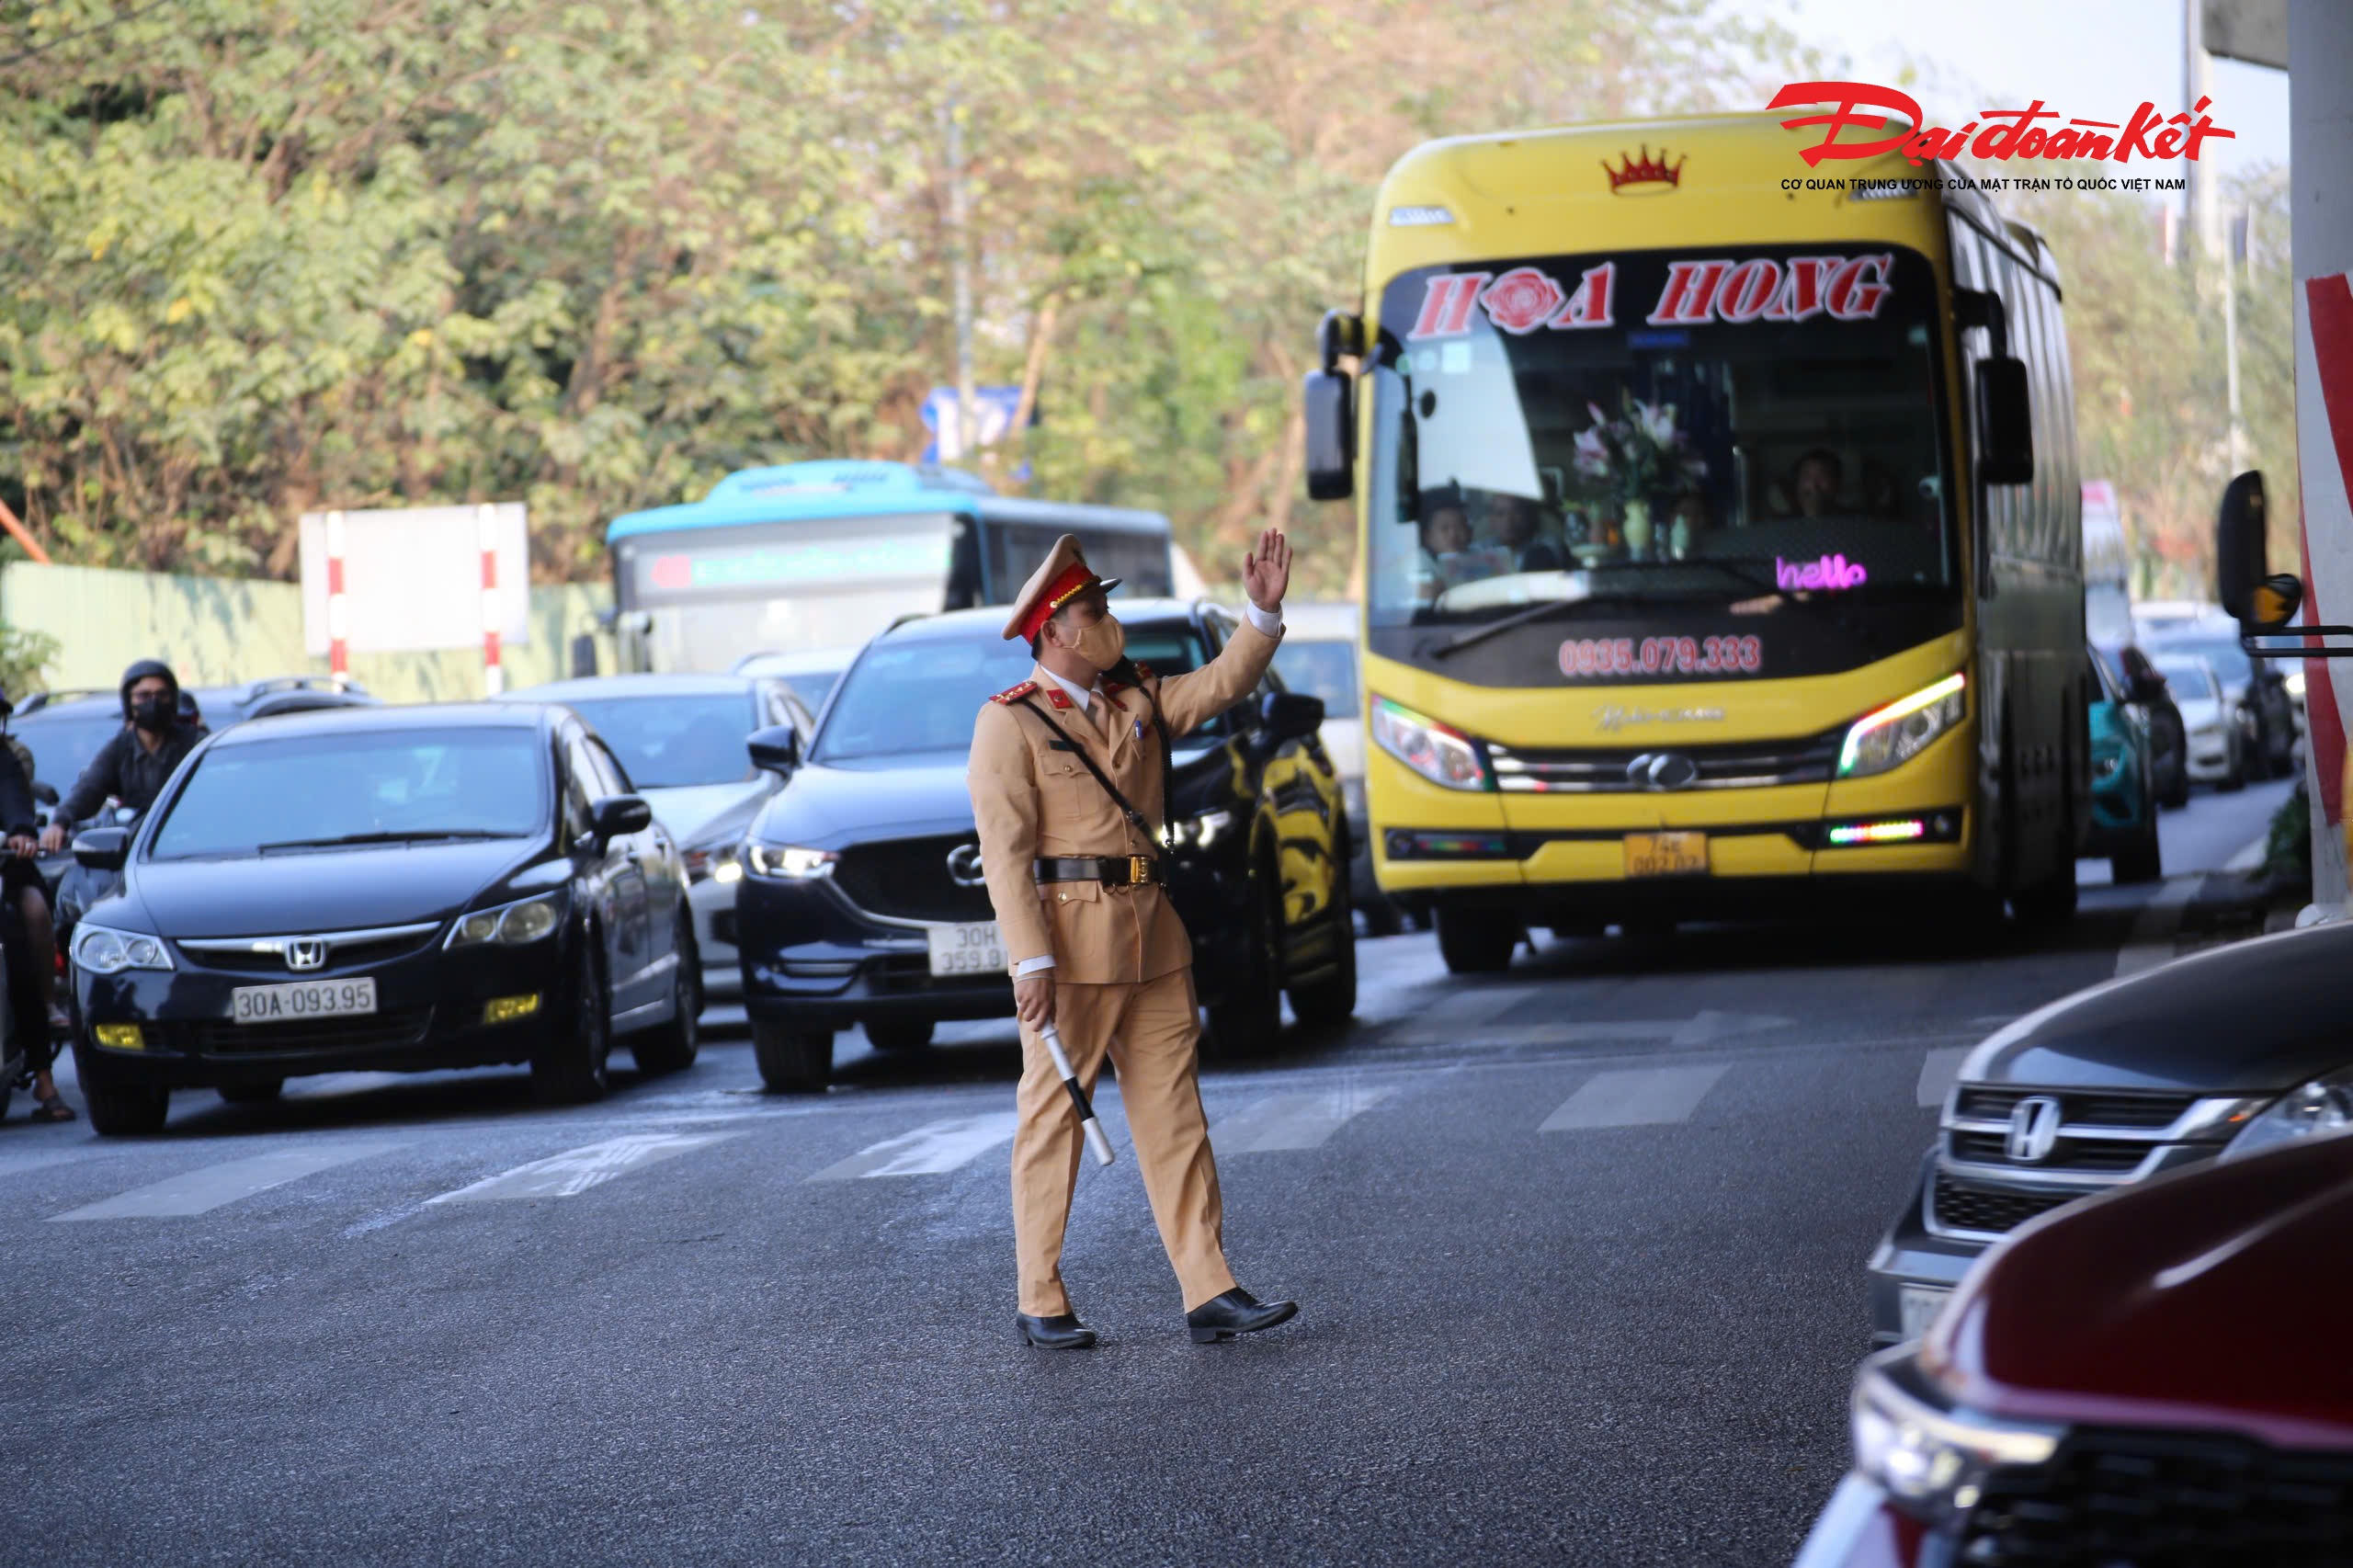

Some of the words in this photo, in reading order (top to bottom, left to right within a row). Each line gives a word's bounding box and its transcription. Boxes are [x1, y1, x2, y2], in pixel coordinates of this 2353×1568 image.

[1645, 253, 1893, 324] HONG
[1776, 553, 1868, 590] hello
[1559, 634, 1761, 676] 0935.079.333
[237, 983, 371, 1018] 30A-093.95
